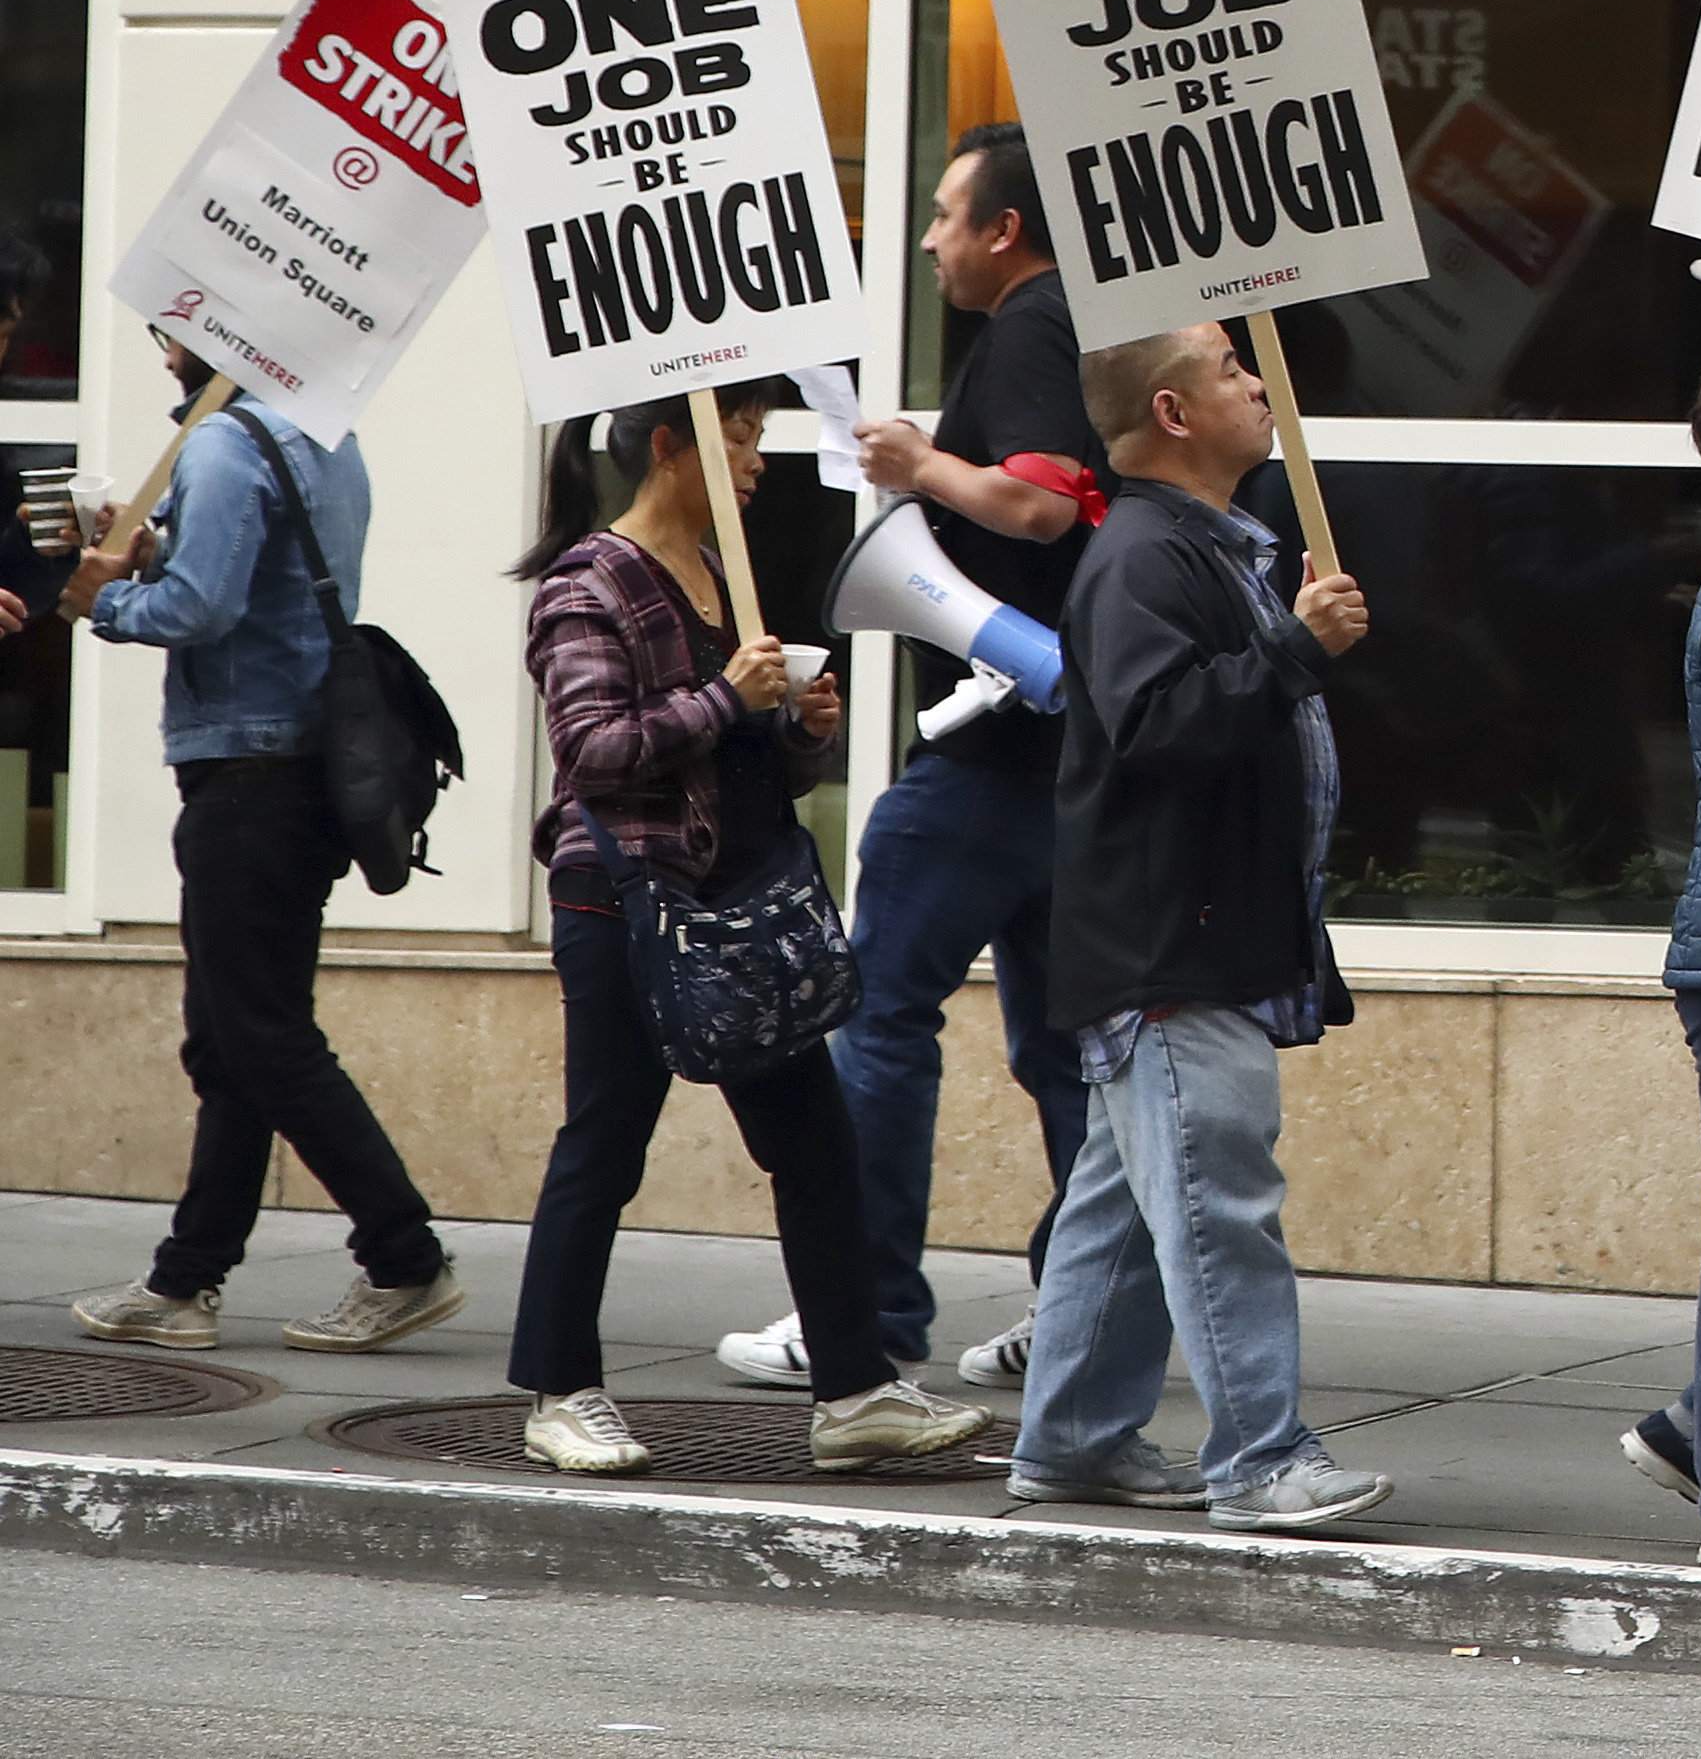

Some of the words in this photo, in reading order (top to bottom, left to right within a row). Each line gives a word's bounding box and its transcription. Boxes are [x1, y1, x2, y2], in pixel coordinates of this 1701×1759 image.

[530, 43, 750, 126] JOB
[1105, 21, 1283, 86] SHOULD
[304, 34, 476, 185] STRIKE
[1175, 71, 1235, 114] BE
[566, 106, 736, 164] SHOULD
[635, 153, 688, 191] BE
[1067, 89, 1384, 283] ENOUGH
[261, 184, 371, 272] Marriott
[202, 199, 278, 264] Union
[283, 258, 376, 333] Square
[527, 173, 830, 357] ENOUGH
[1200, 266, 1301, 300] UNITEHERE!
[203, 315, 305, 393] UNITEHERE!
[650, 344, 747, 376] UNITEHERE!
[907, 573, 949, 604] PYLE
